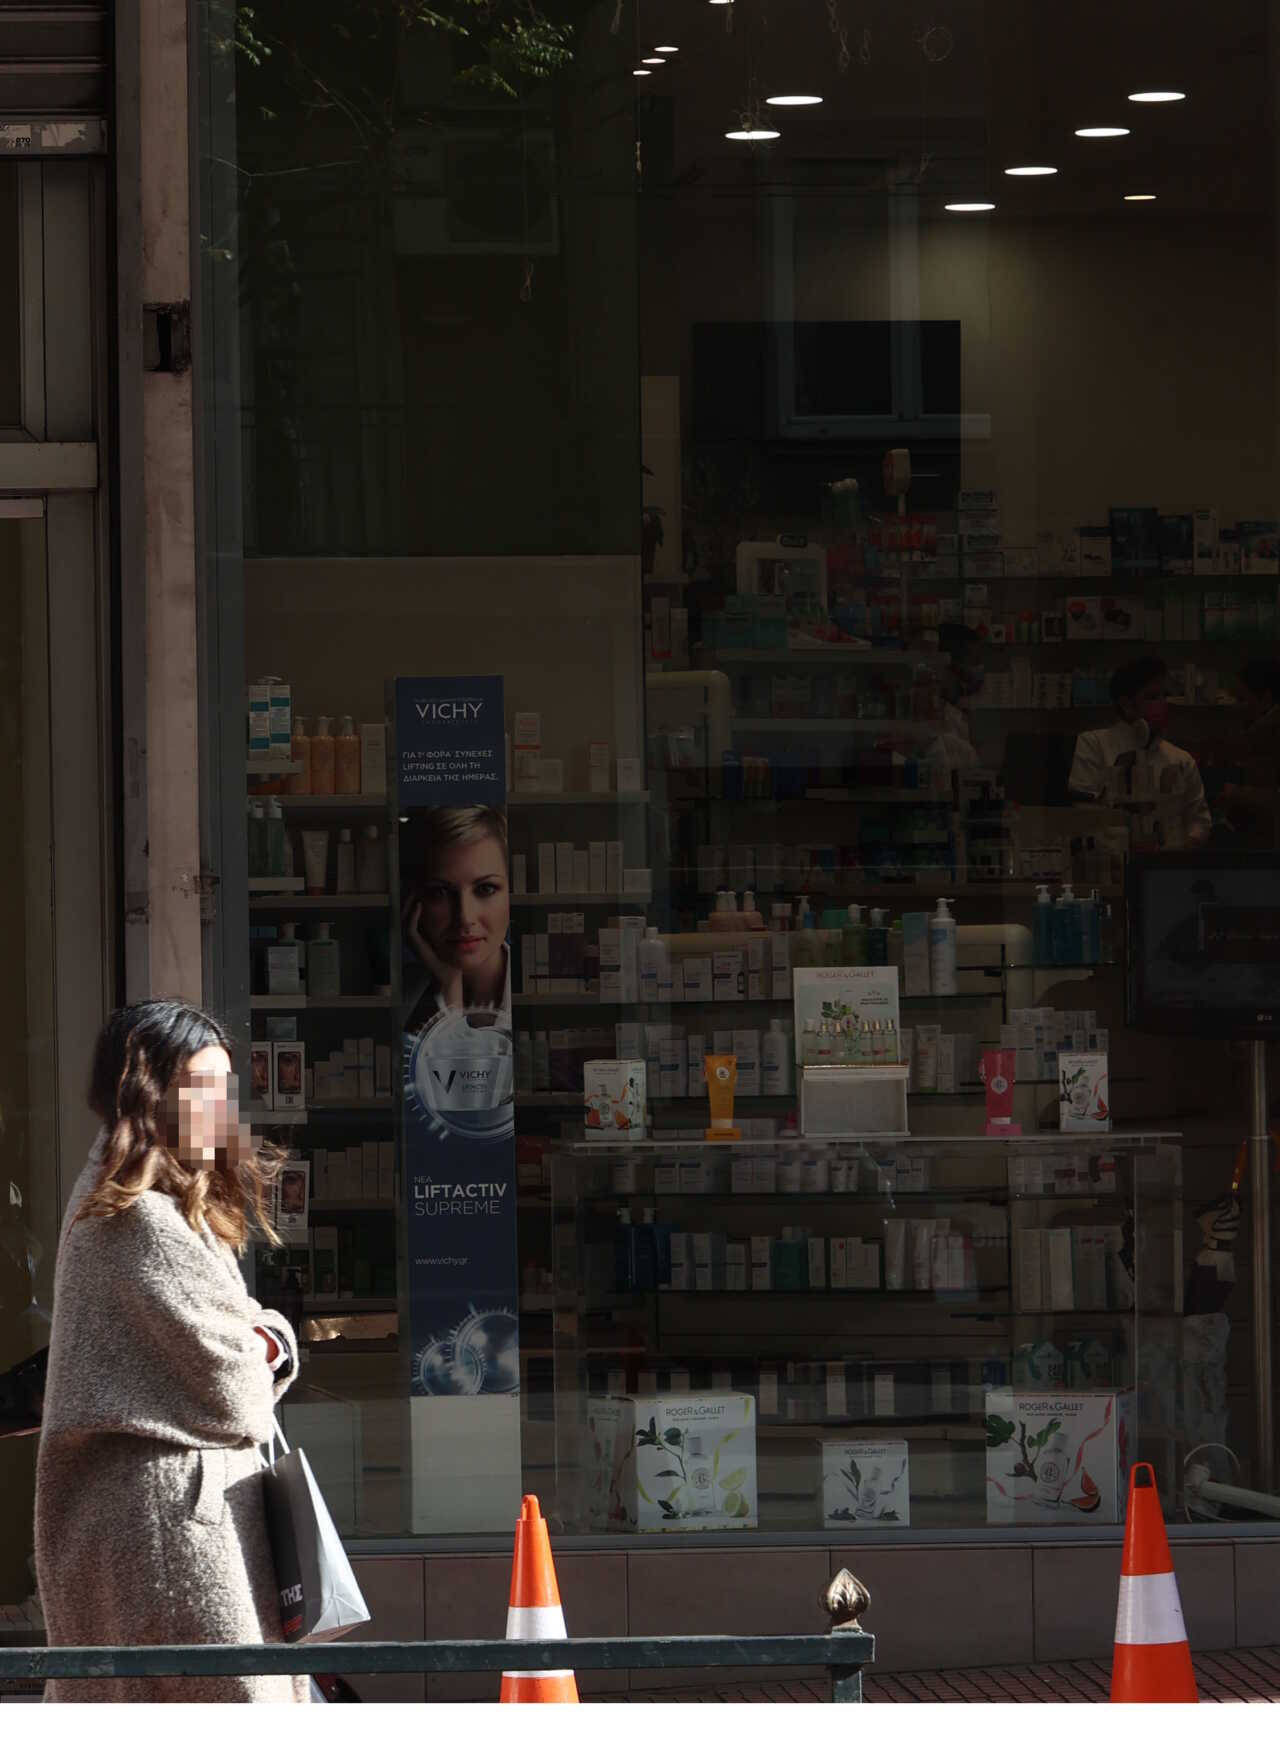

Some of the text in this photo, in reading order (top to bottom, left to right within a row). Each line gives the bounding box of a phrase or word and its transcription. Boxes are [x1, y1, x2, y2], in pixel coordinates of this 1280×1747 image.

[415, 703, 484, 719] VICHY
[402, 762, 435, 771] LIFTING
[436, 762, 447, 770] ΣΕ
[469, 761, 481, 769] ΤΗ
[403, 774, 442, 783] ΔΙΑΡΚΕΙΑ
[459, 1070, 490, 1079] VICHY
[414, 1183, 507, 1199] LIFTACTIV
[415, 1200, 502, 1216] SUPREME
